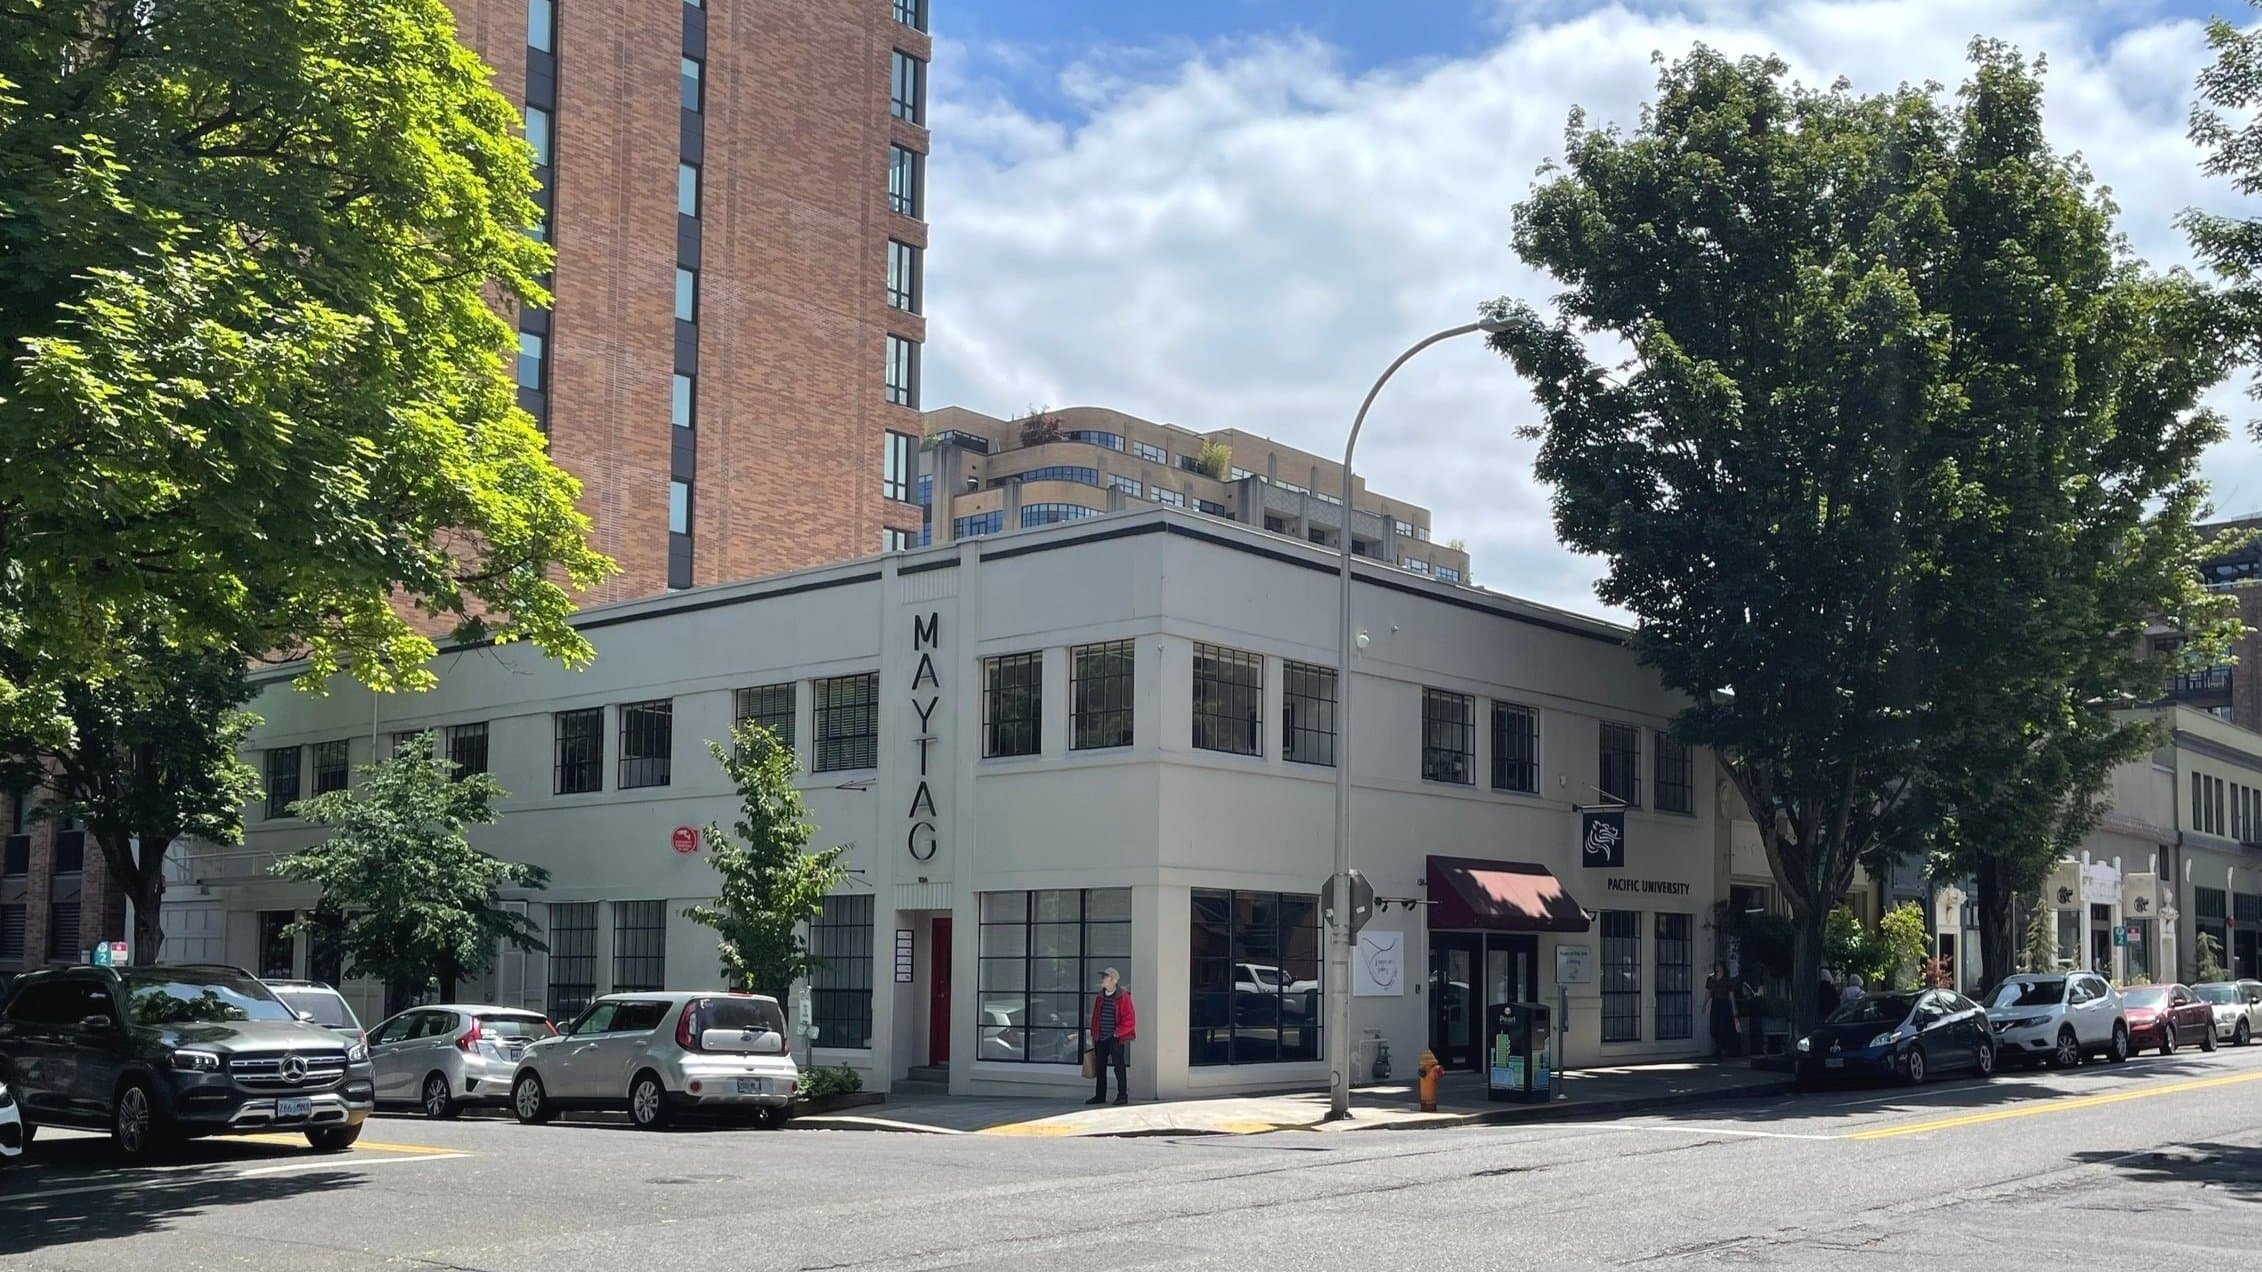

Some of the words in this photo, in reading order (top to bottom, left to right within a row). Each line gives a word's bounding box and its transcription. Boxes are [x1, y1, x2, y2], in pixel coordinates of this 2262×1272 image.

[908, 612, 940, 861] MAYTAG
[1607, 878, 1640, 893] PACIFIC
[1641, 880, 1690, 896] UNIVERSITY
[99, 953, 107, 963] 2
